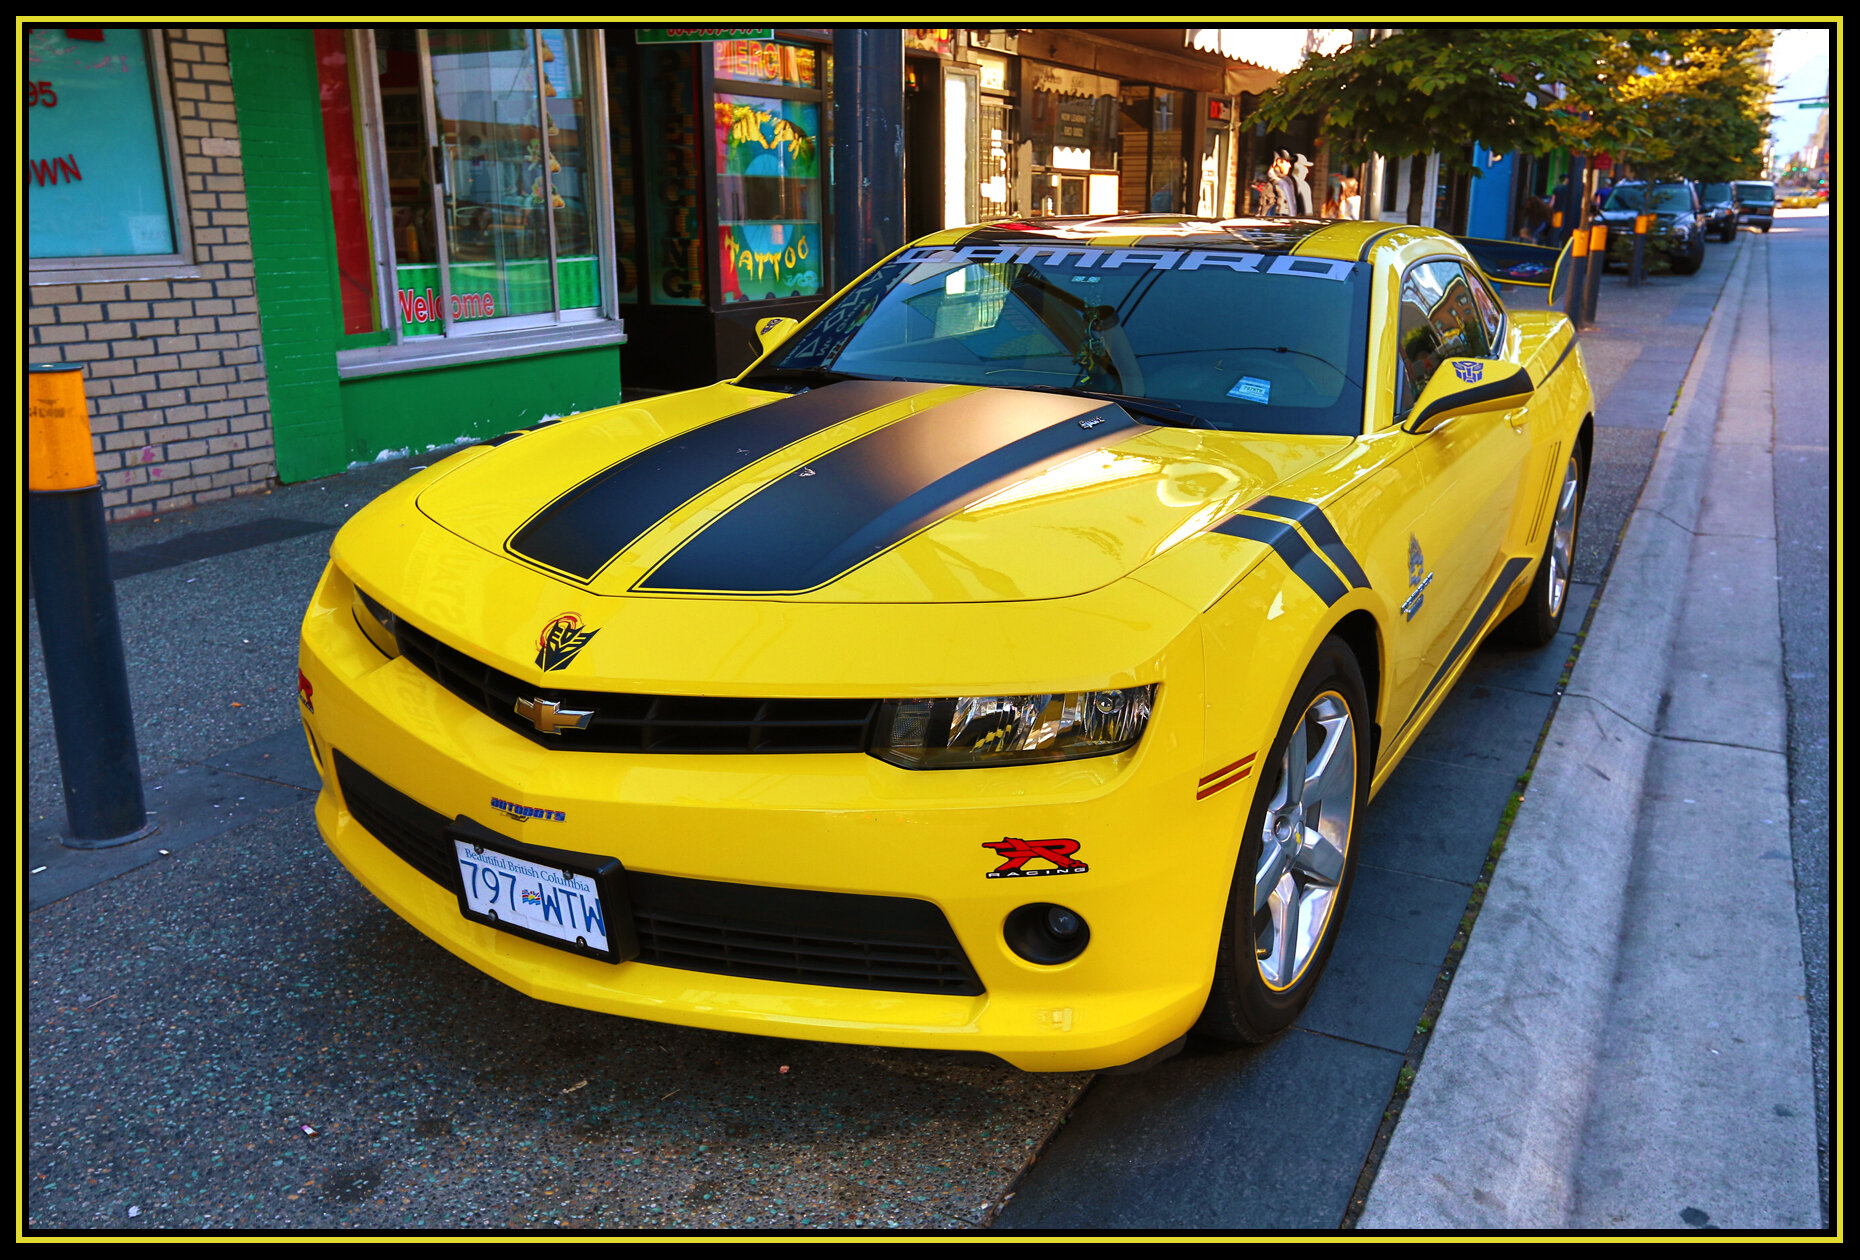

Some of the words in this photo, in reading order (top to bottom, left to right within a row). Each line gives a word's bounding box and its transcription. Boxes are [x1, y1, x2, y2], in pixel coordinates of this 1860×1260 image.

[714, 39, 817, 84] PIERCING
[724, 228, 810, 284] TATTOO
[893, 245, 1356, 282] CAMARO
[491, 796, 566, 821] AUTOBOTS
[464, 847, 507, 869] Beautiful
[507, 860, 540, 880] British
[540, 870, 591, 893] Columbia
[988, 866, 1086, 878] RACING
[460, 859, 517, 911] 797
[538, 882, 607, 937] WTW
